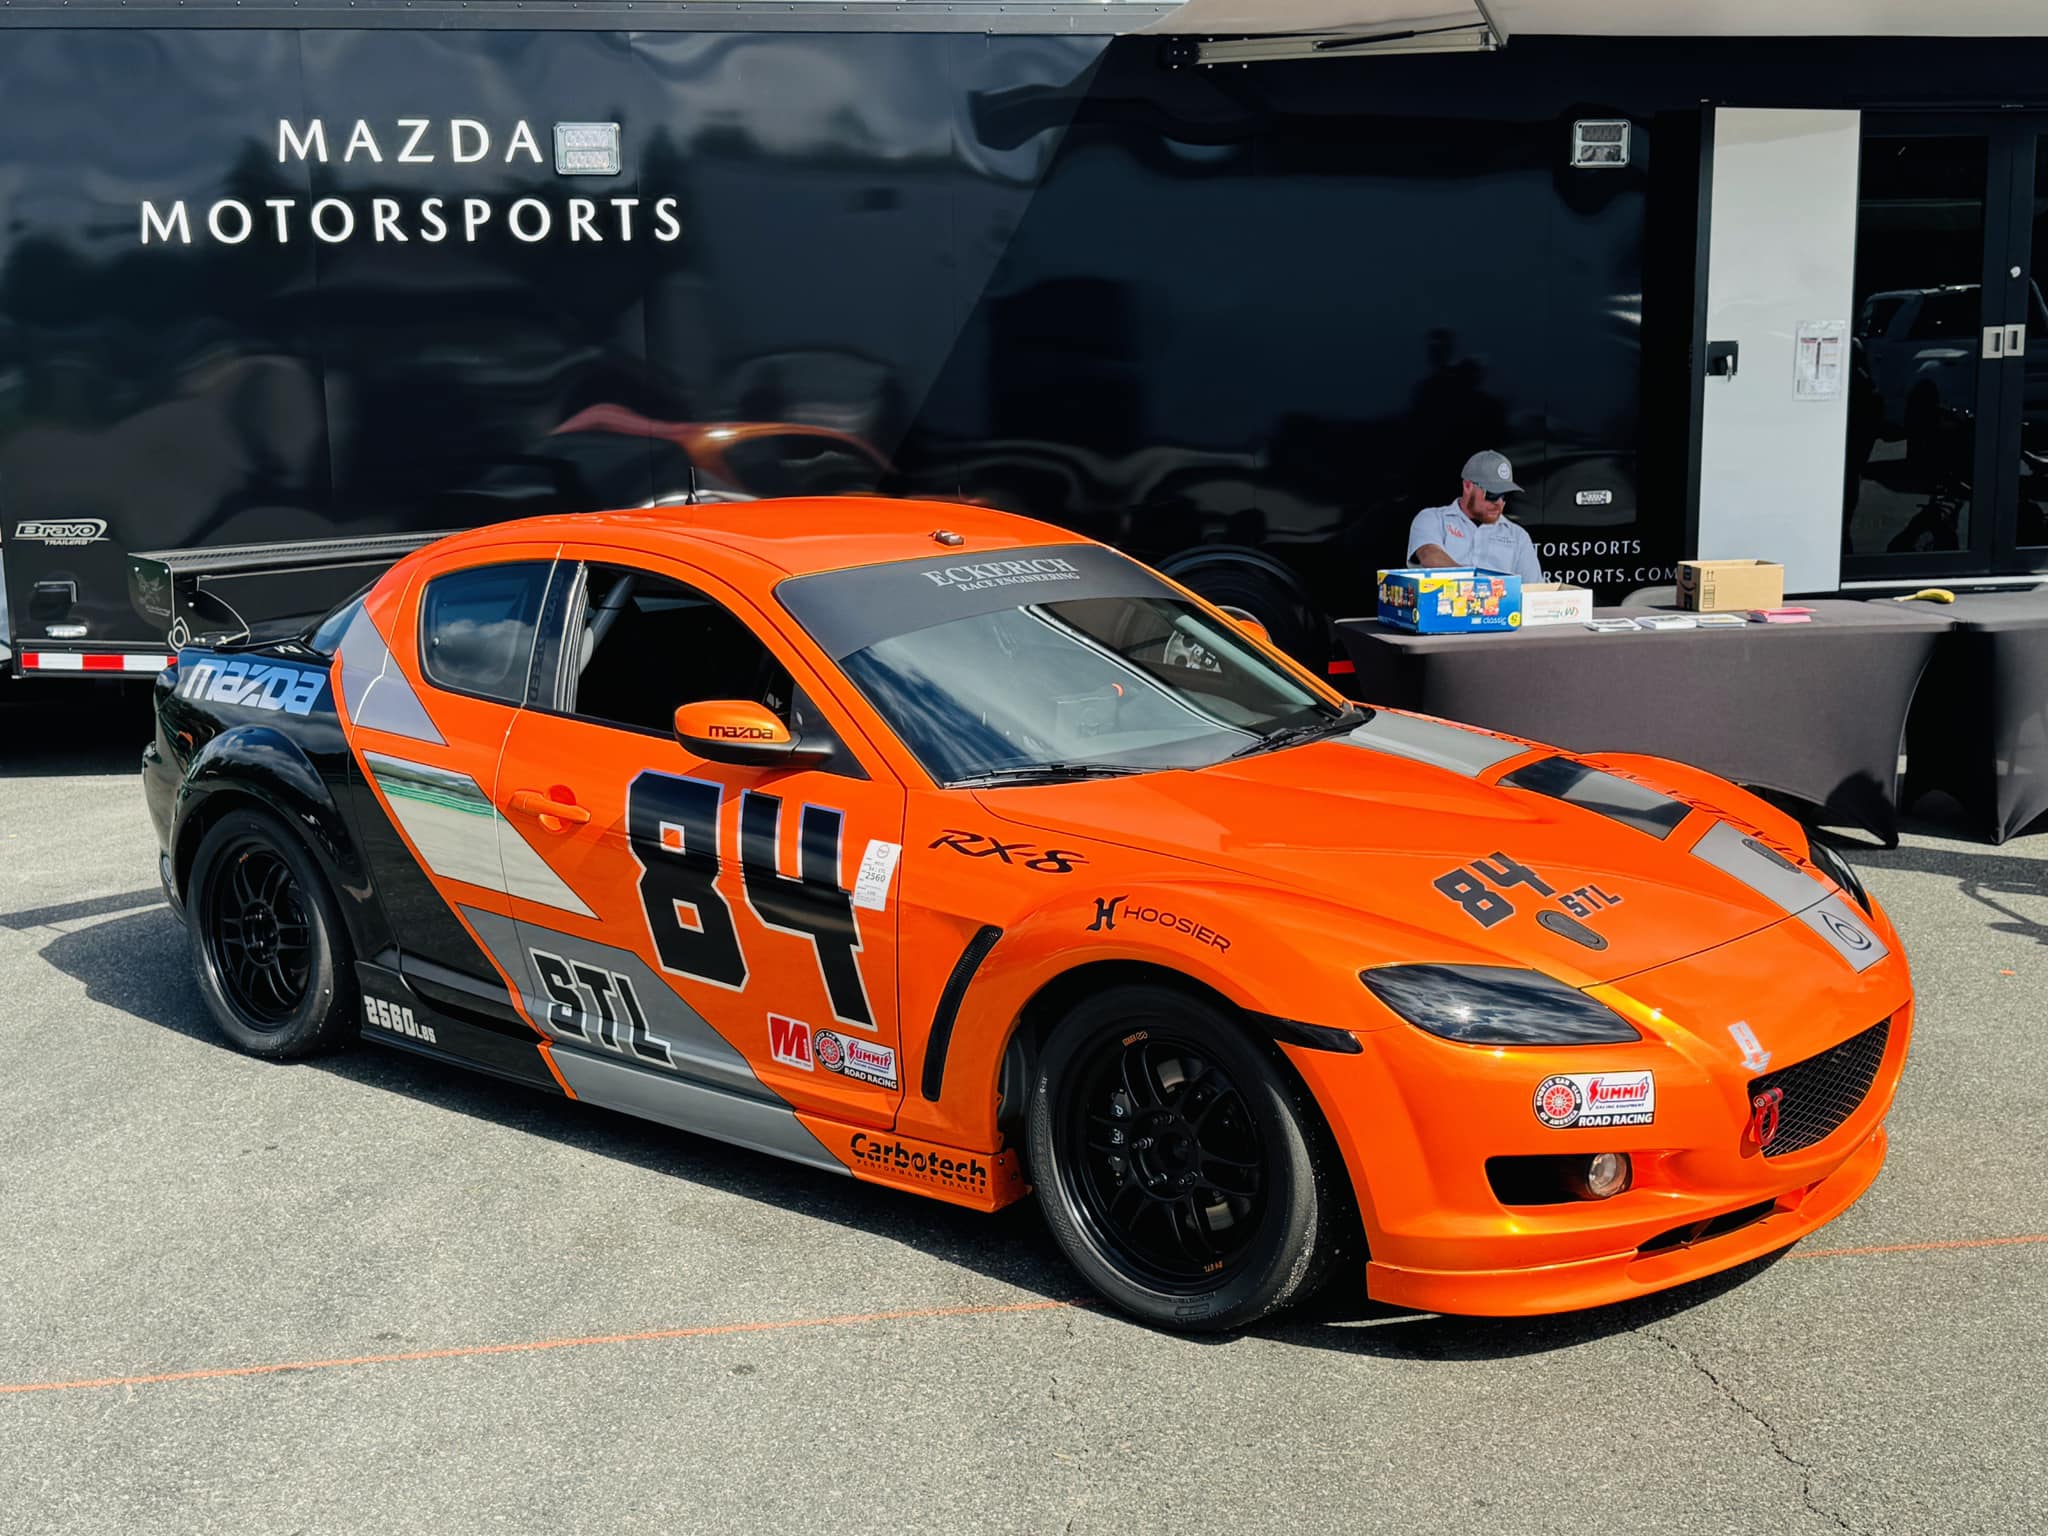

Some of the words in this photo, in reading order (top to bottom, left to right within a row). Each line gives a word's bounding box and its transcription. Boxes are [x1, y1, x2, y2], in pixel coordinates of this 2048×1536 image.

[278, 118, 544, 164] MAZDA
[140, 197, 682, 245] MOTORSPORTS
[44, 538, 89, 546] TRAILERS
[920, 557, 1079, 587] ECKERICH
[958, 578, 996, 592] RACE
[998, 570, 1081, 586] ENGINEERING
[928, 829, 1091, 874] RX-8
[624, 767, 879, 1033] 84
[864, 870, 887, 885] 2560
[1432, 851, 1557, 929] 84
[1557, 884, 1623, 918] STL
[1123, 905, 1232, 954] HOOSIER
[528, 946, 678, 1070] STL
[844, 1067, 867, 1080] ROAD
[867, 1072, 898, 1089] RACING
[1578, 1114, 1611, 1127] ROAD
[1612, 1113, 1653, 1126] RACING
[850, 1132, 987, 1187] Carbotech
